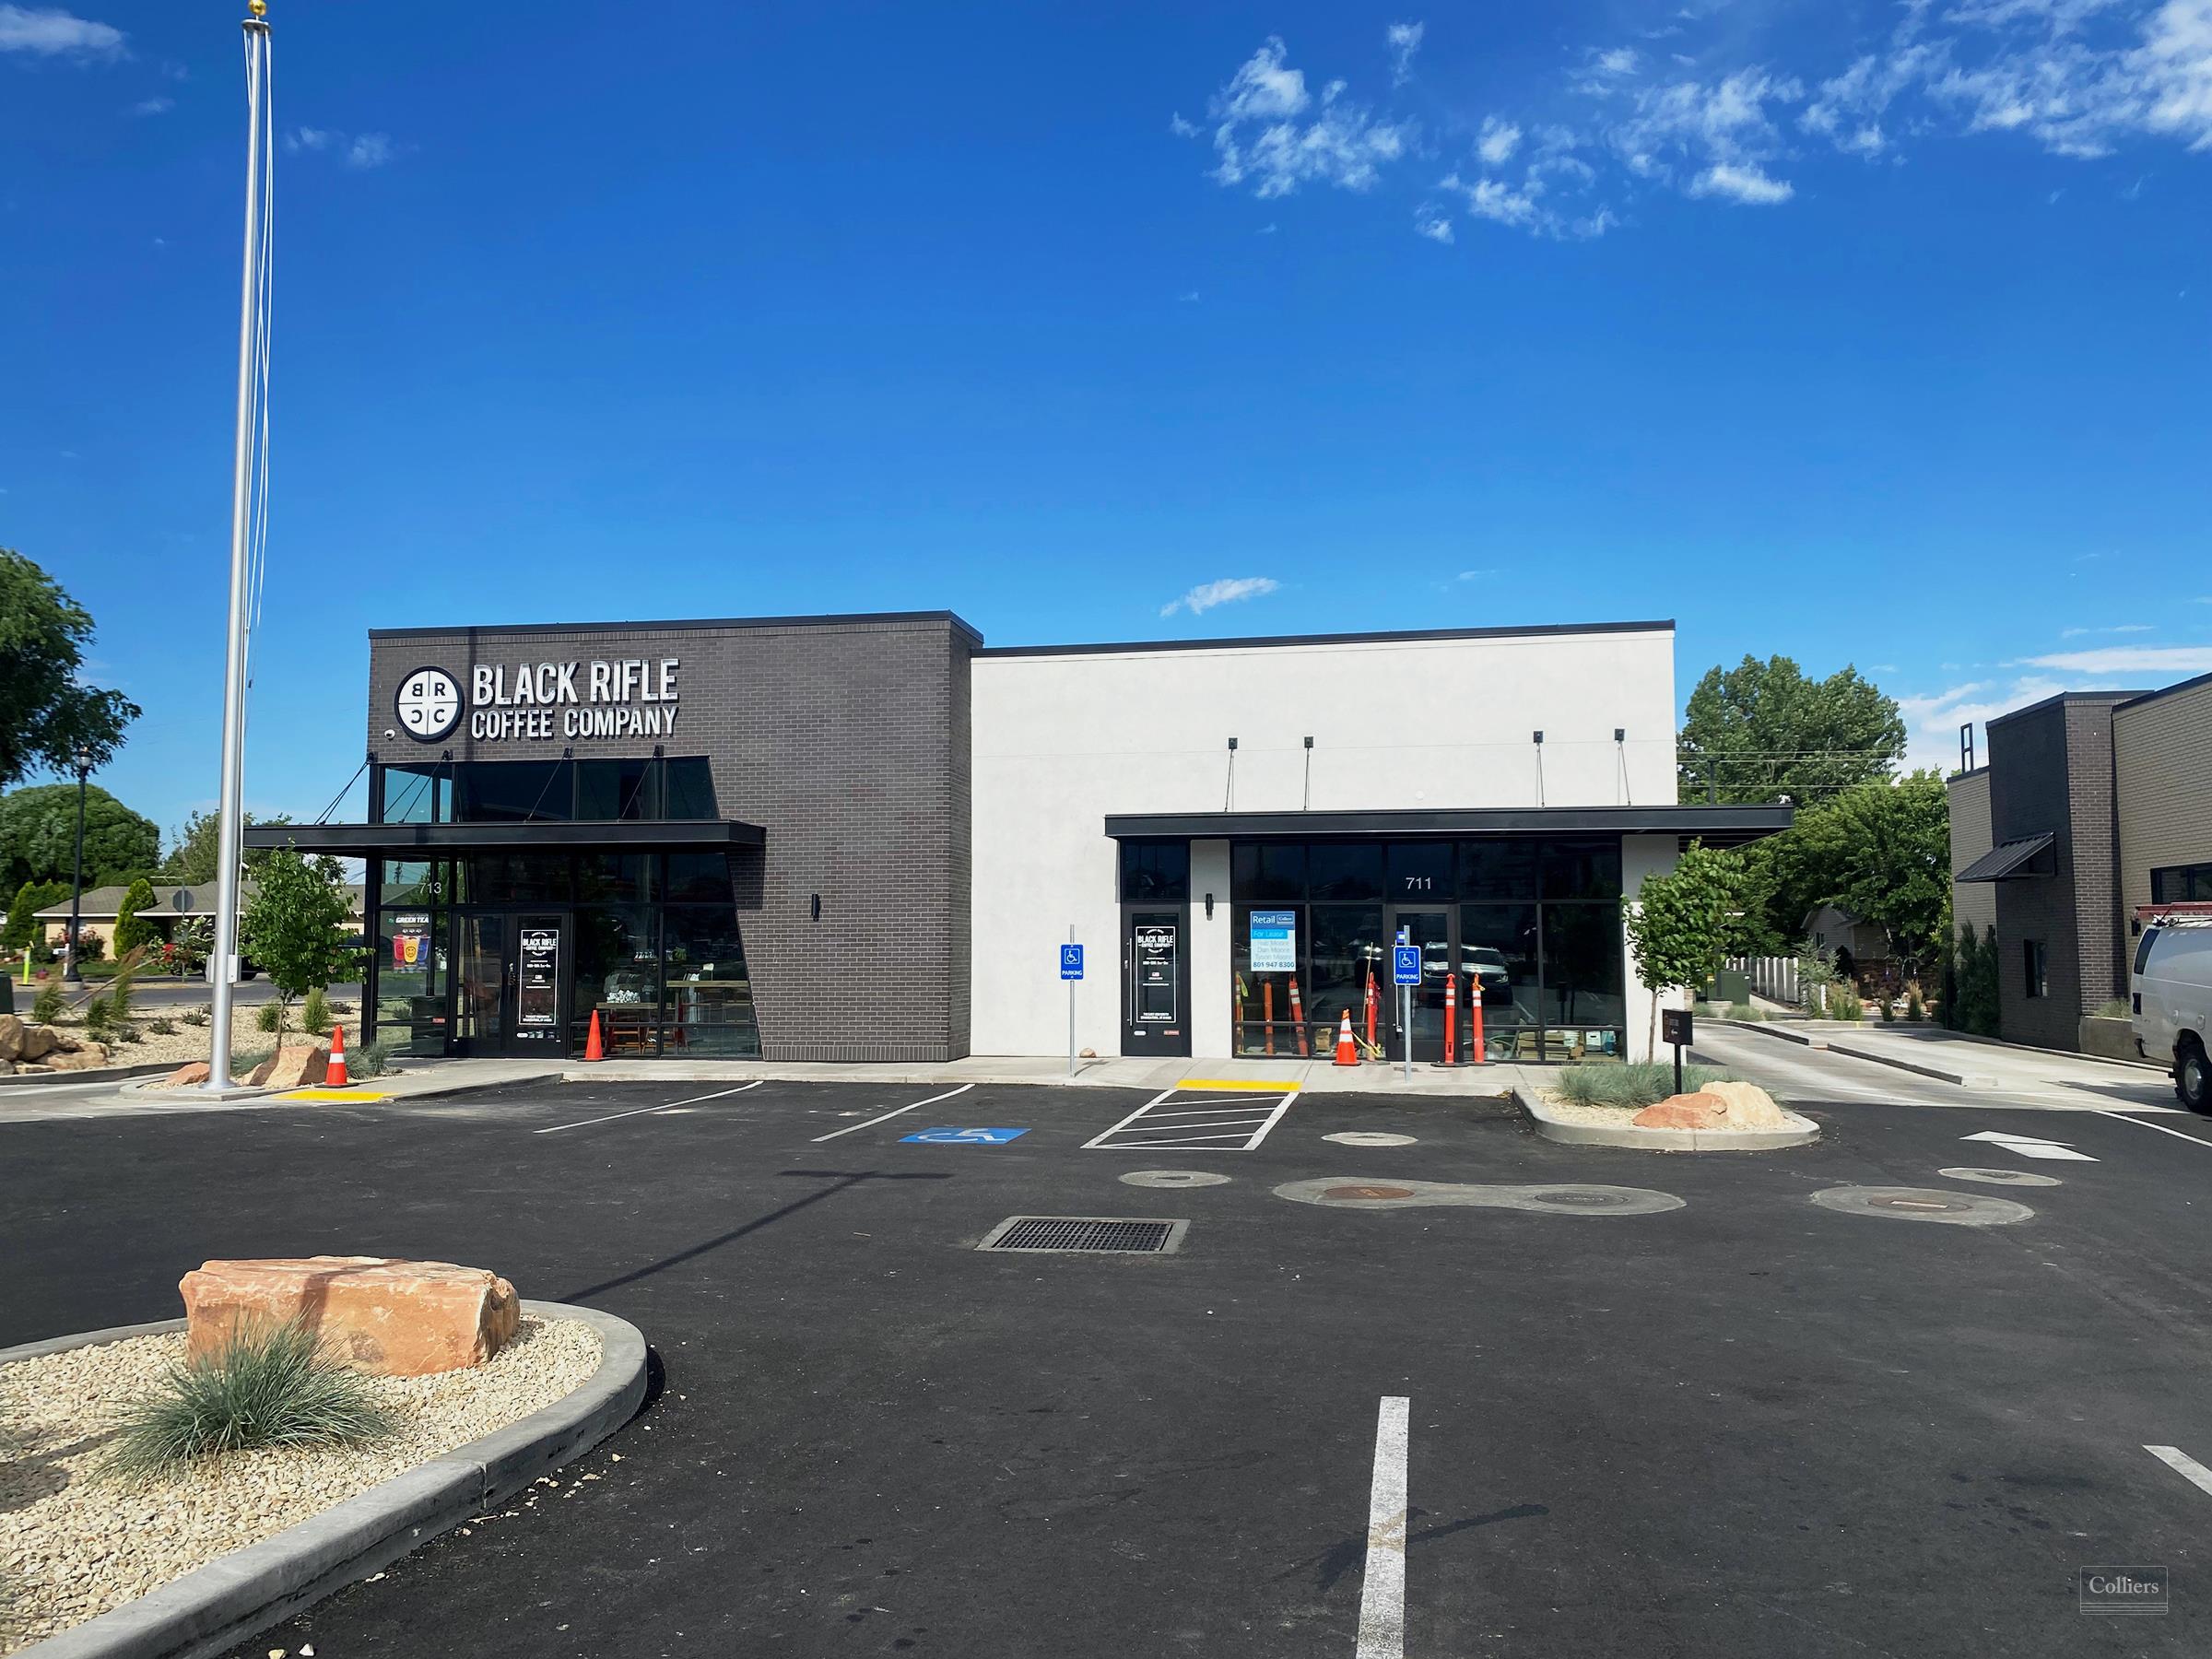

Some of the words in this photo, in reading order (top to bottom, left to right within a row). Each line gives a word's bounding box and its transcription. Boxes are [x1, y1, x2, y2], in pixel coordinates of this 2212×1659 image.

[472, 662, 580, 706] BLACK
[590, 658, 680, 703] RIFLE
[471, 709, 554, 739] COFFEE
[564, 706, 679, 737] COMPANY
[419, 882, 442, 894] 713
[1406, 877, 1431, 889] 711
[1253, 915, 1276, 924] Retail
[523, 938, 541, 947] BLACK
[542, 938, 557, 947] RIFLE
